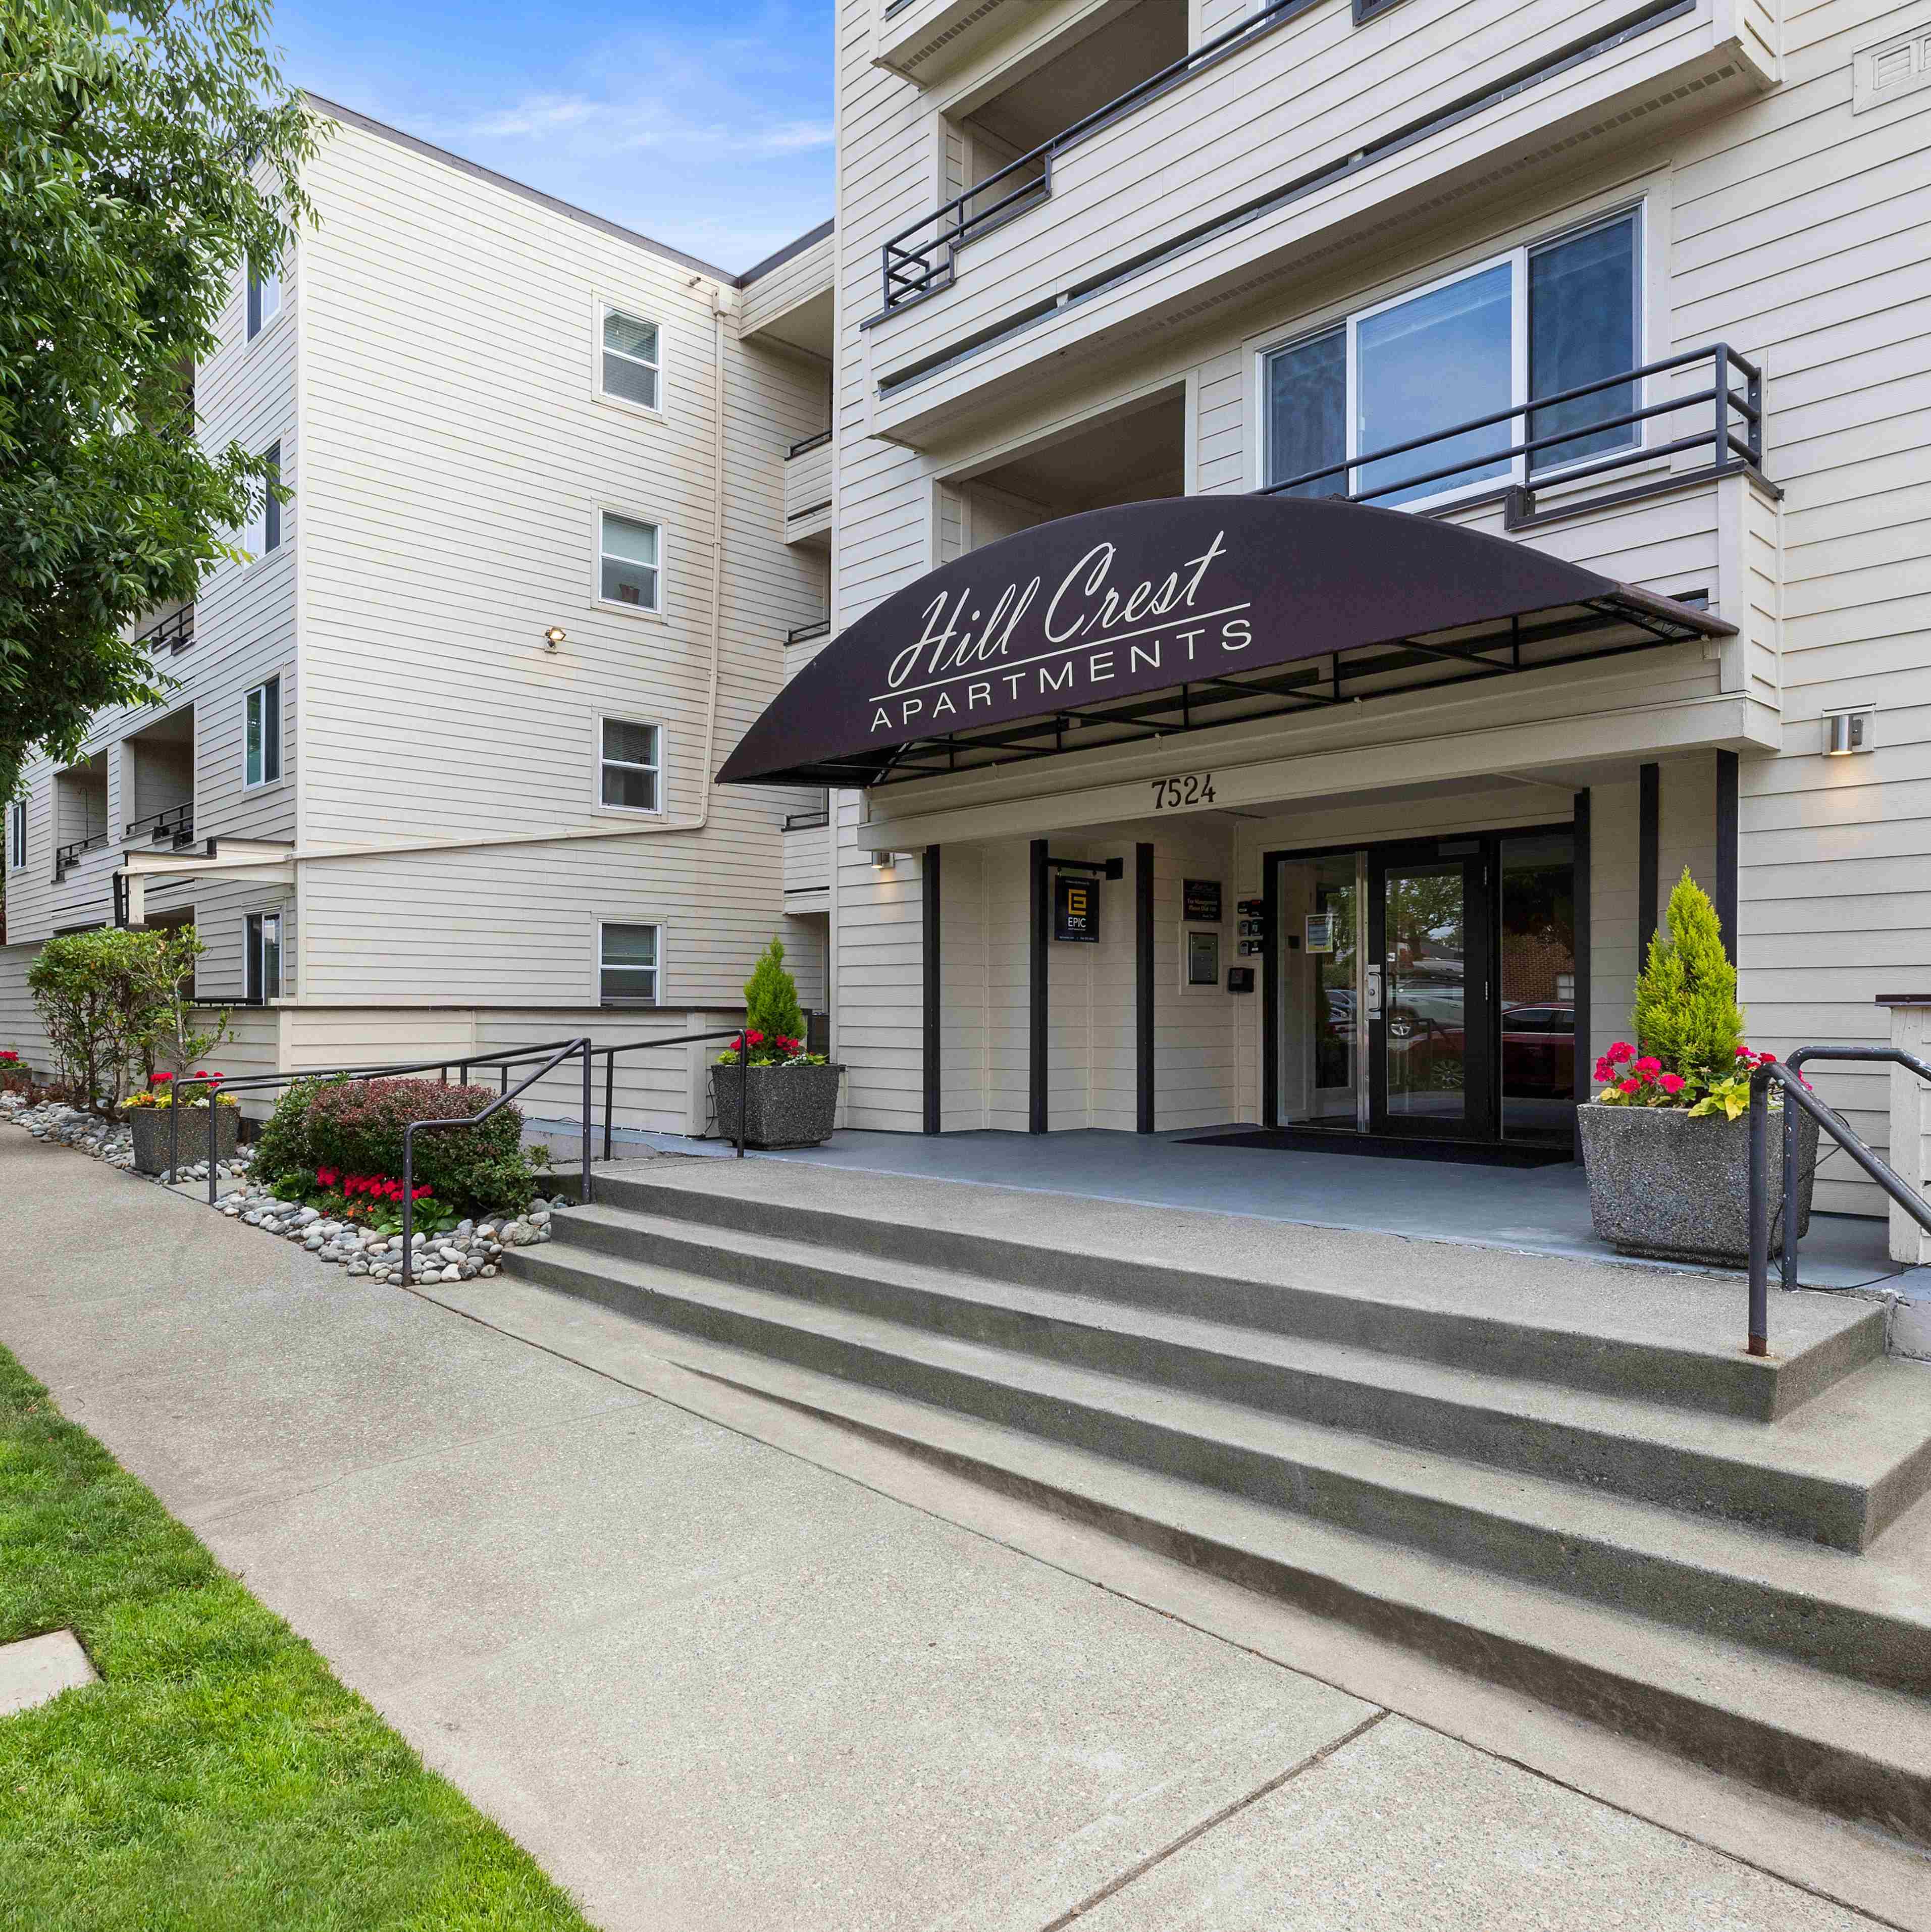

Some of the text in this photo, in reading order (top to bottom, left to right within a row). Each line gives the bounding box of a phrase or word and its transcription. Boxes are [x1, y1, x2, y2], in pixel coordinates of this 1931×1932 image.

[888, 530, 1227, 688] Hill Crest
[870, 619, 1252, 732] APARTMENTS
[1152, 773, 1216, 809] 7524
[1068, 917, 1086, 928] EPIC
